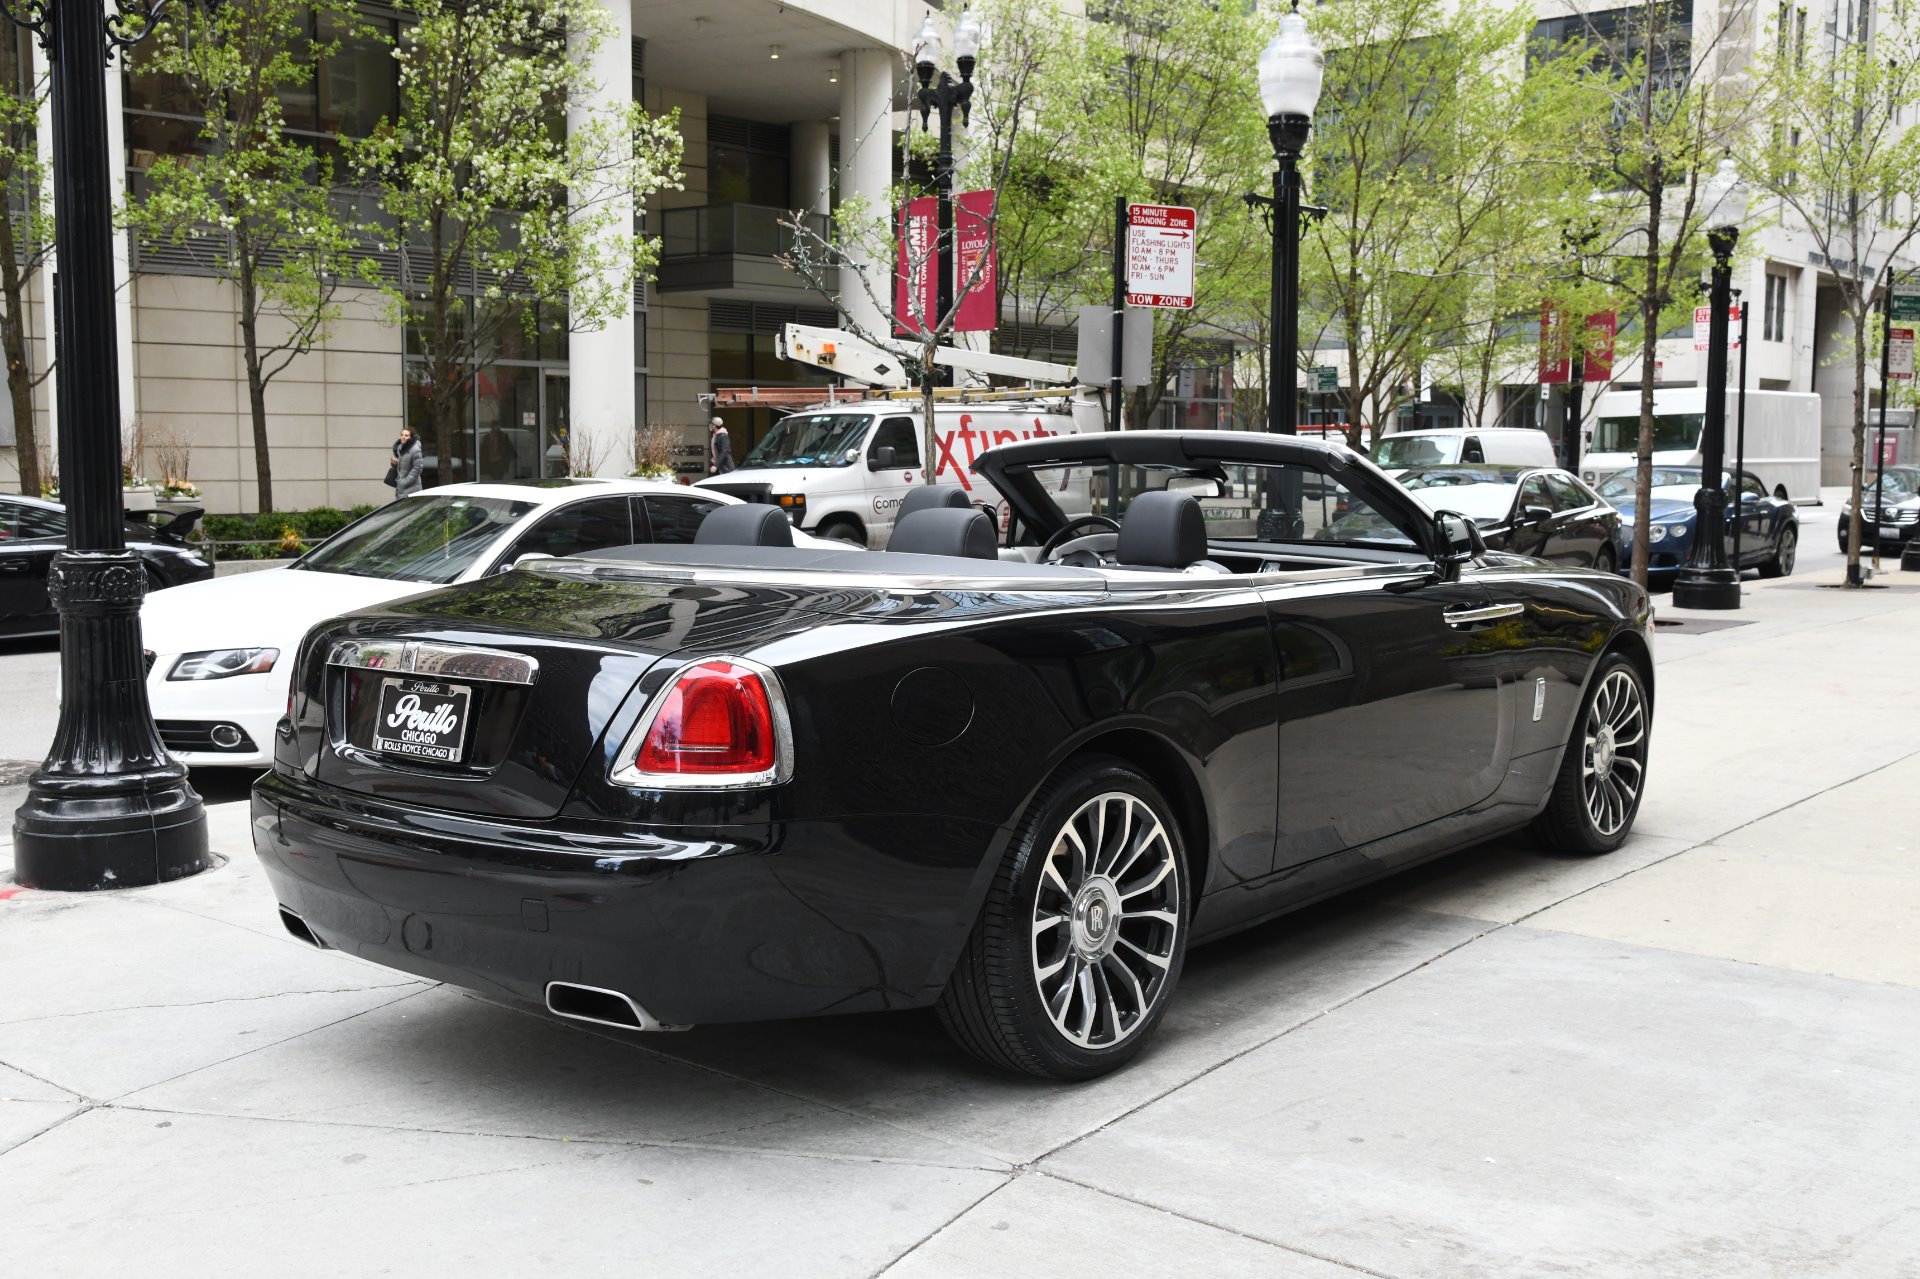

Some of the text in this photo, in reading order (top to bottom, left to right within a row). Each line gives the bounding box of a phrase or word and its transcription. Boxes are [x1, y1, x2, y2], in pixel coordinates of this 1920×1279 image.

[1133, 207, 1167, 217] 15 MINUTE
[1133, 216, 1188, 228] STANDING ZONE
[1132, 238, 1191, 249] FLASHING LIGHTS
[907, 215, 921, 316] WOME
[1155, 256, 1179, 265] THURS
[1131, 271, 1143, 279] FRI
[1164, 265, 1175, 273] PM
[1131, 293, 1187, 307] TOW ZONE
[411, 681, 440, 693] Perillo
[387, 694, 458, 735] Perillo
[401, 729, 437, 745] CHICAGO
[384, 740, 448, 758] ROLLS ROYCE CHICAGO
